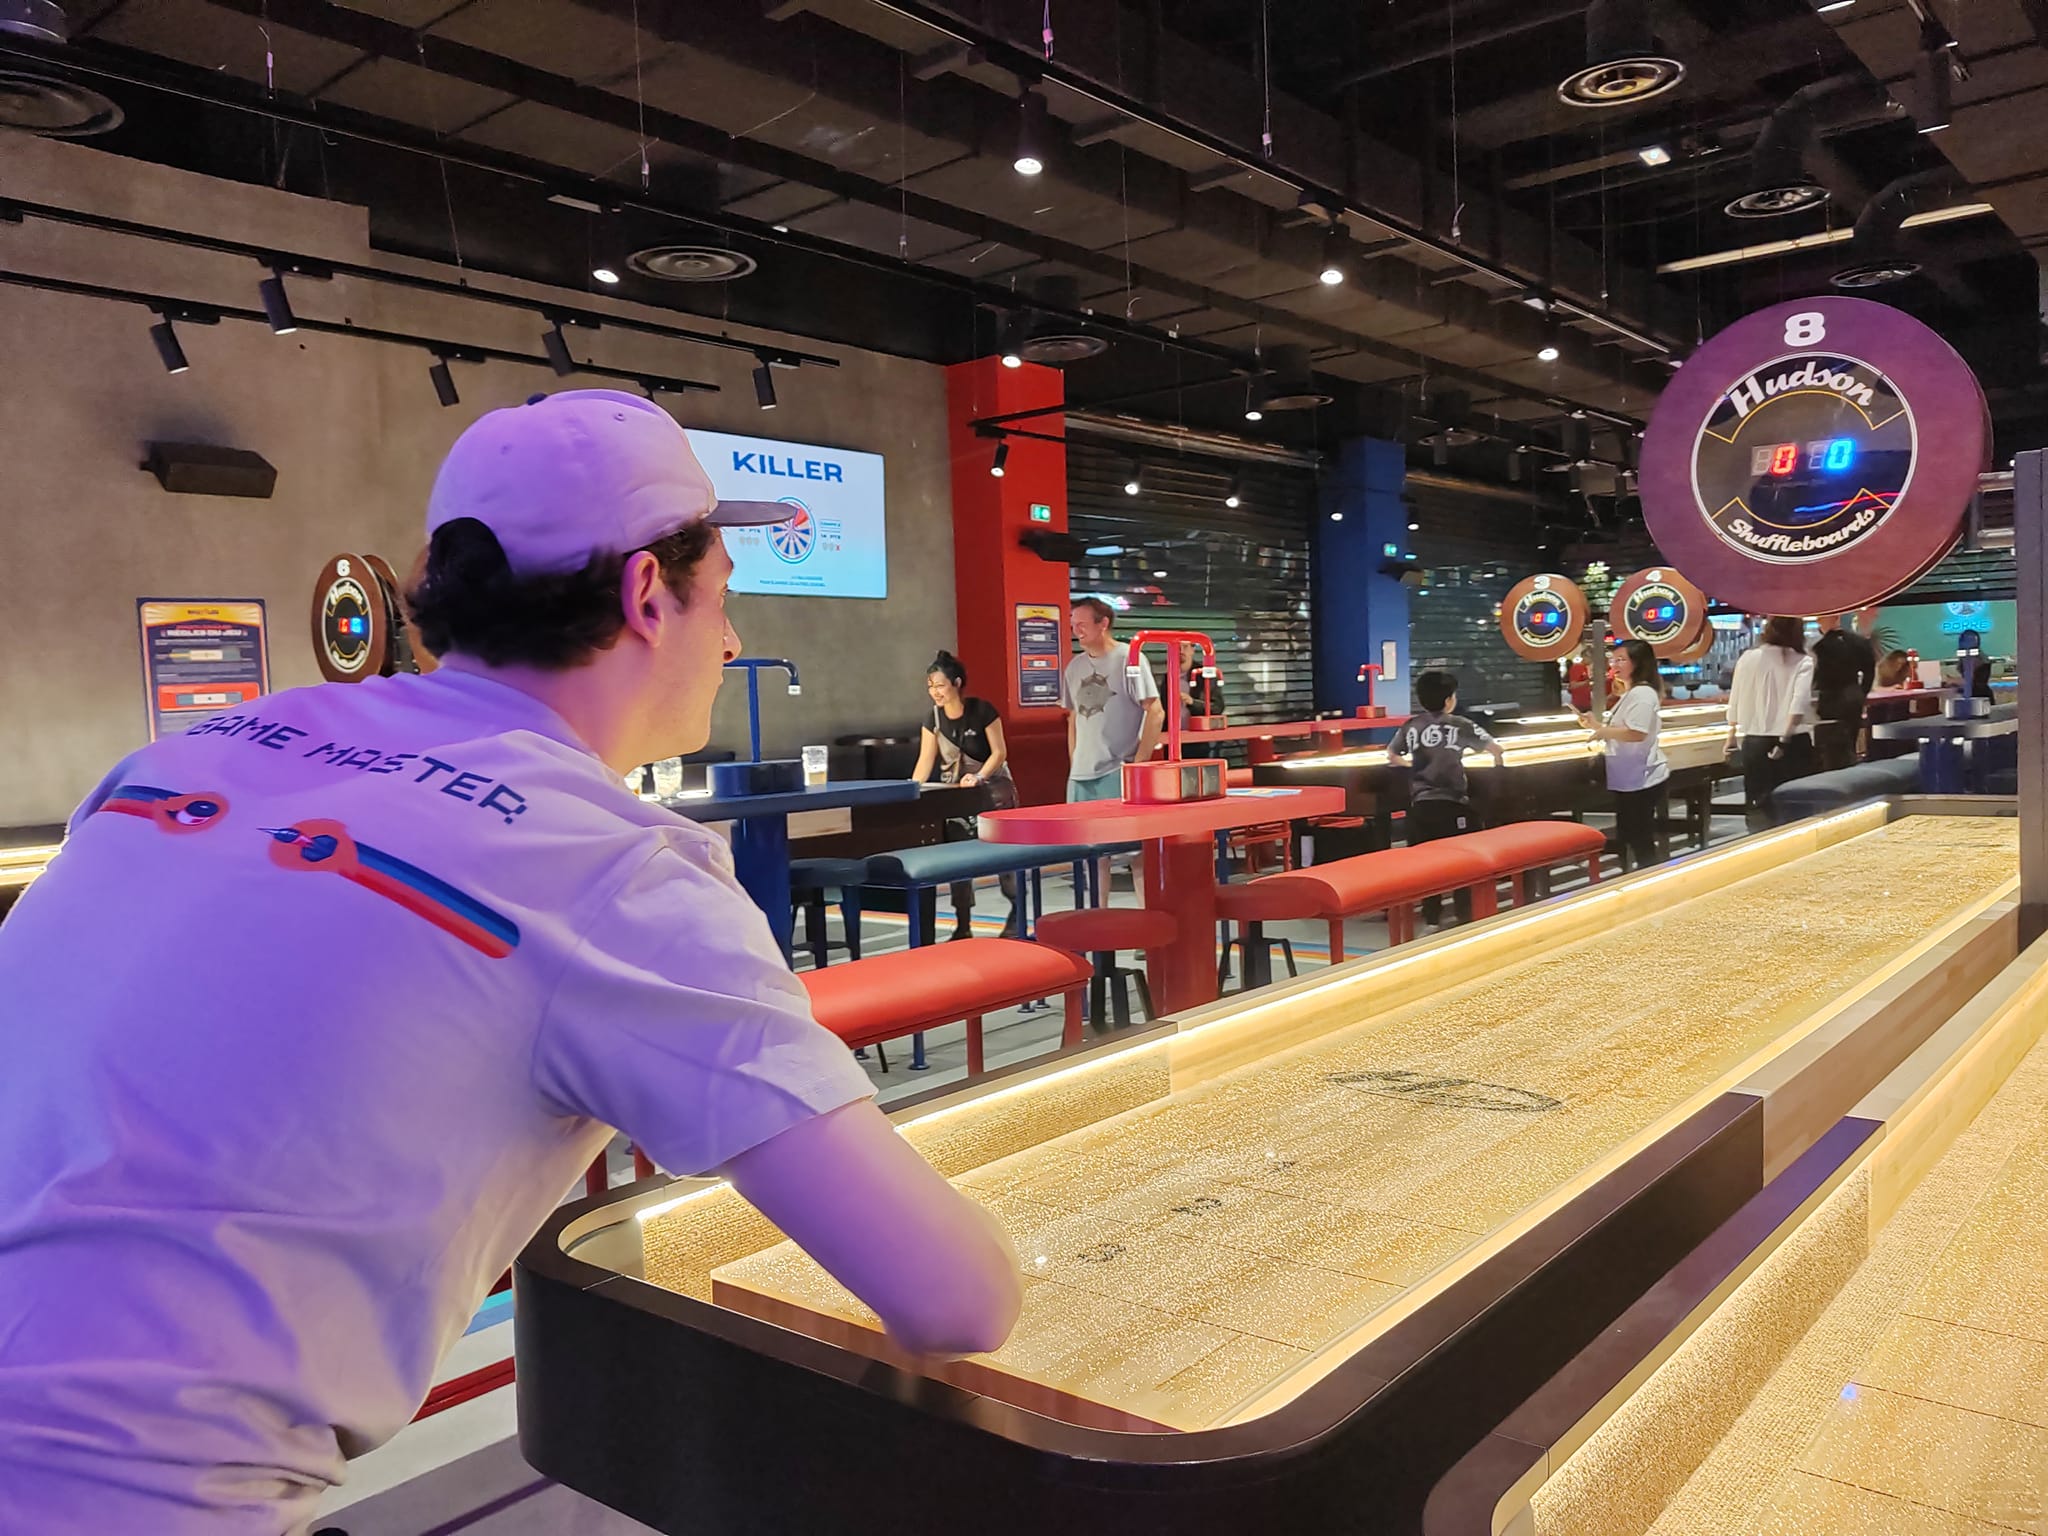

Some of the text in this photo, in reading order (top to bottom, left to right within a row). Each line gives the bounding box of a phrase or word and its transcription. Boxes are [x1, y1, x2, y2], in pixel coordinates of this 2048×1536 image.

[1783, 311, 1826, 347] 8
[1728, 361, 1875, 418] Hudson
[732, 450, 843, 483] KILLER
[1727, 508, 1876, 552] Shuffleboards
[1533, 575, 1551, 590] 3
[1645, 569, 1663, 582] 4
[186, 715, 309, 750] GAME
[303, 742, 528, 825] MASTER
